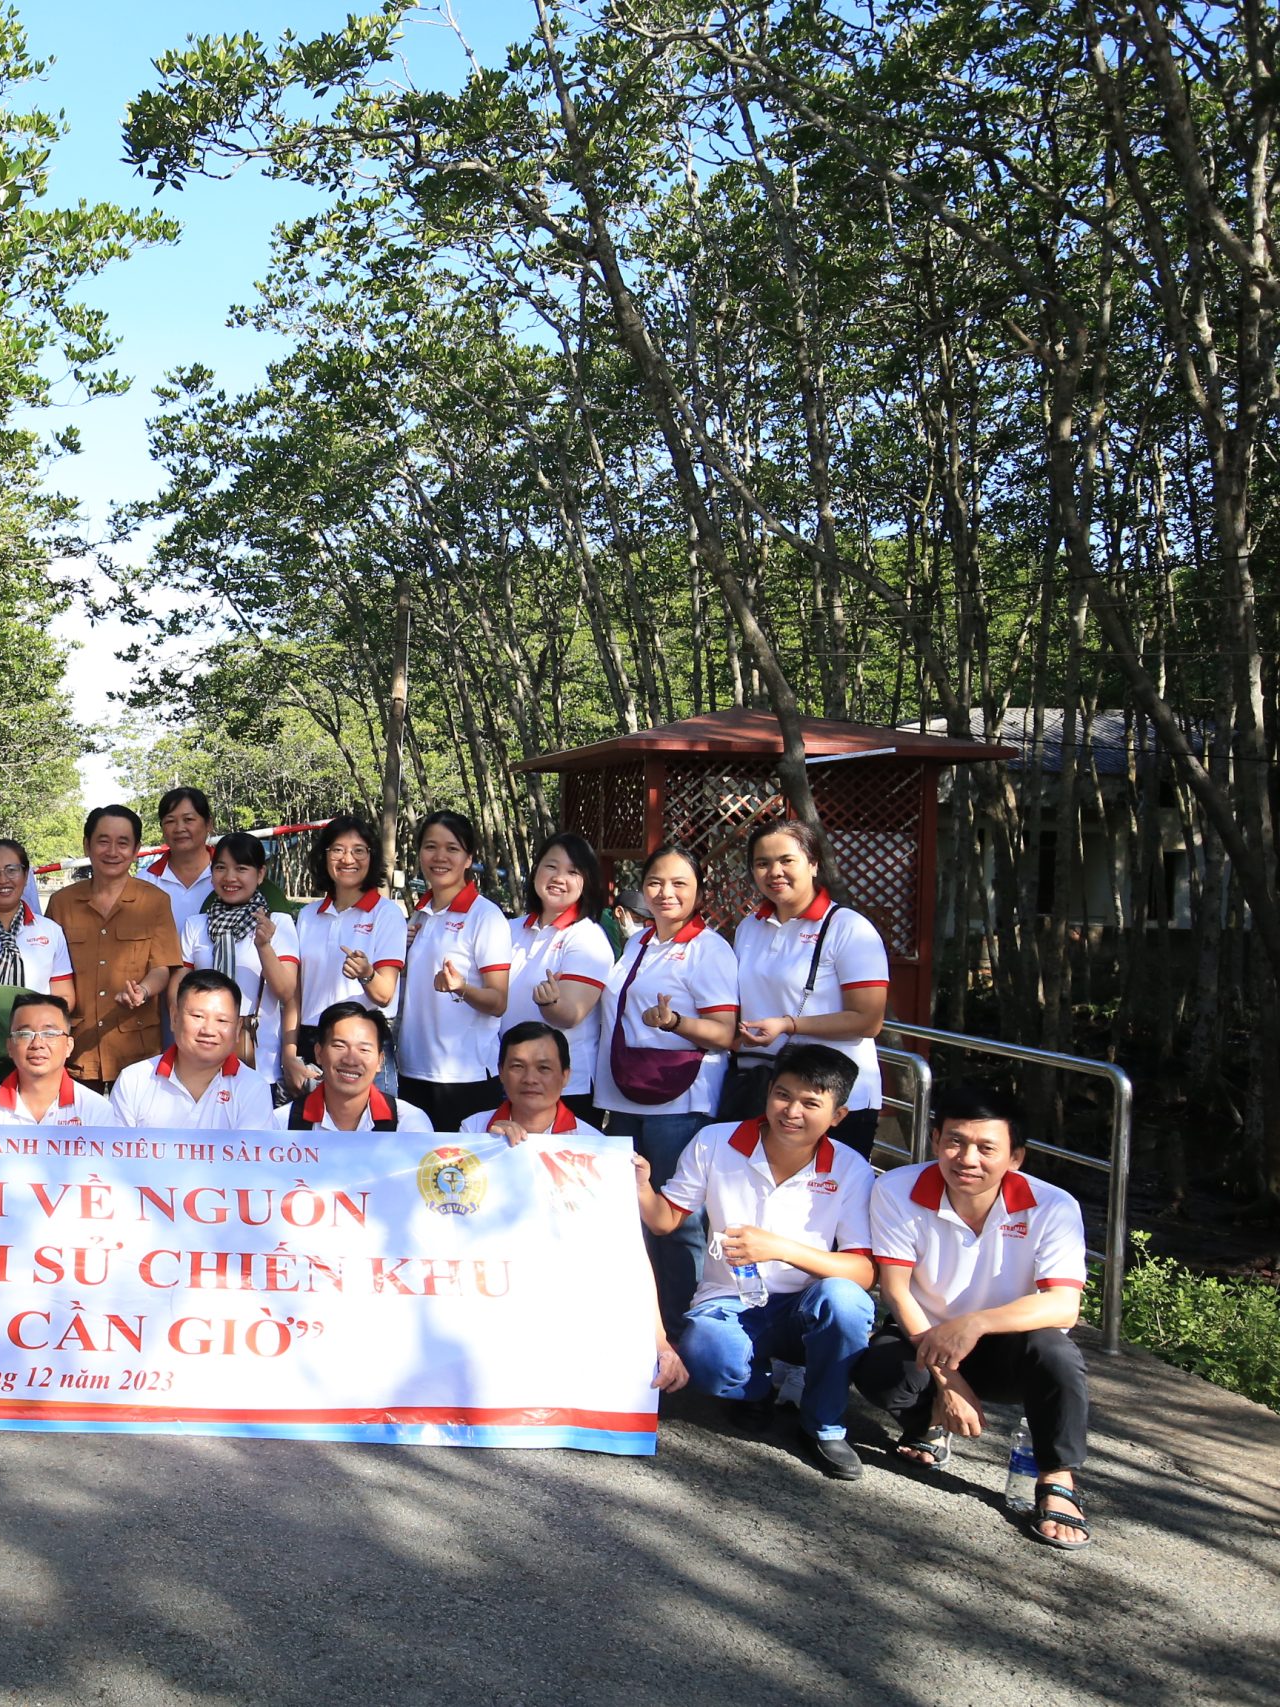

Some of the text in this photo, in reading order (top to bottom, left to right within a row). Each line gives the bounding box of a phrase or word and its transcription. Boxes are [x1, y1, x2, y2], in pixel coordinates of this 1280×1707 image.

[47, 1136, 104, 1157] NIÊN
[112, 1138, 166, 1158] SIÊU
[174, 1143, 216, 1163] THỊ
[222, 1141, 261, 1162] SÀI
[269, 1143, 320, 1163] GÒN
[27, 1173, 116, 1220] VỀ
[134, 1179, 371, 1228] NGUỒN
[32, 1235, 124, 1287] SỬ
[138, 1242, 346, 1293] CHIẾN
[370, 1257, 512, 1298] KHU
[5, 1300, 147, 1354] CẦN
[167, 1307, 325, 1357] GIỜ”
[23, 1366, 53, 1389] 12
[58, 1368, 112, 1392] năm
[118, 1368, 175, 1393] 2023
